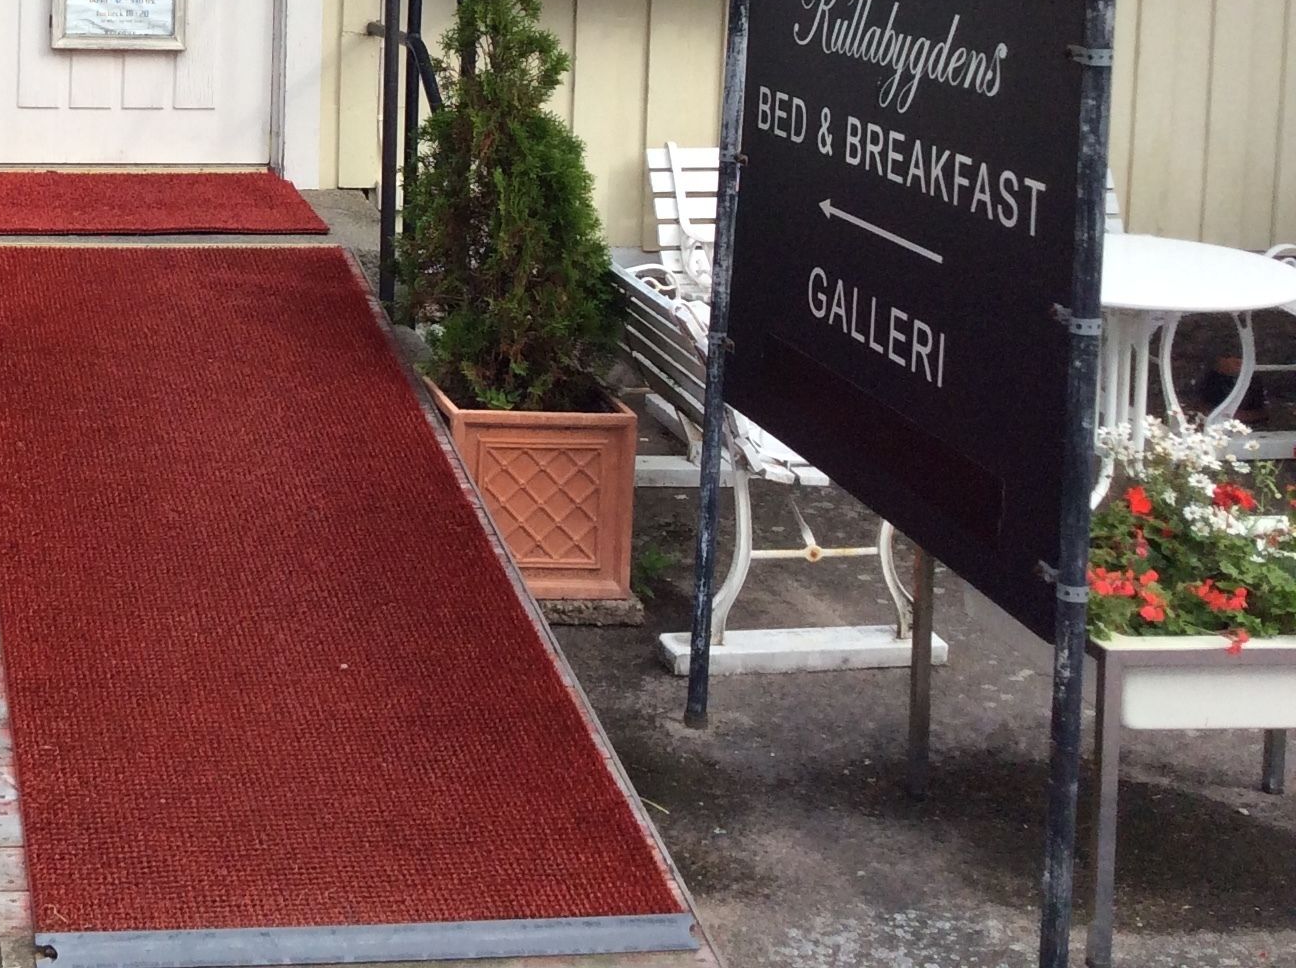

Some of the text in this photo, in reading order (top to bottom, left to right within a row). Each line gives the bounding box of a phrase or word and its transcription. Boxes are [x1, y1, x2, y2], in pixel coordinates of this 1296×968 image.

[757, 85, 1046, 237] BED & BREAKFAST
[807, 266, 945, 388] GALLERI
